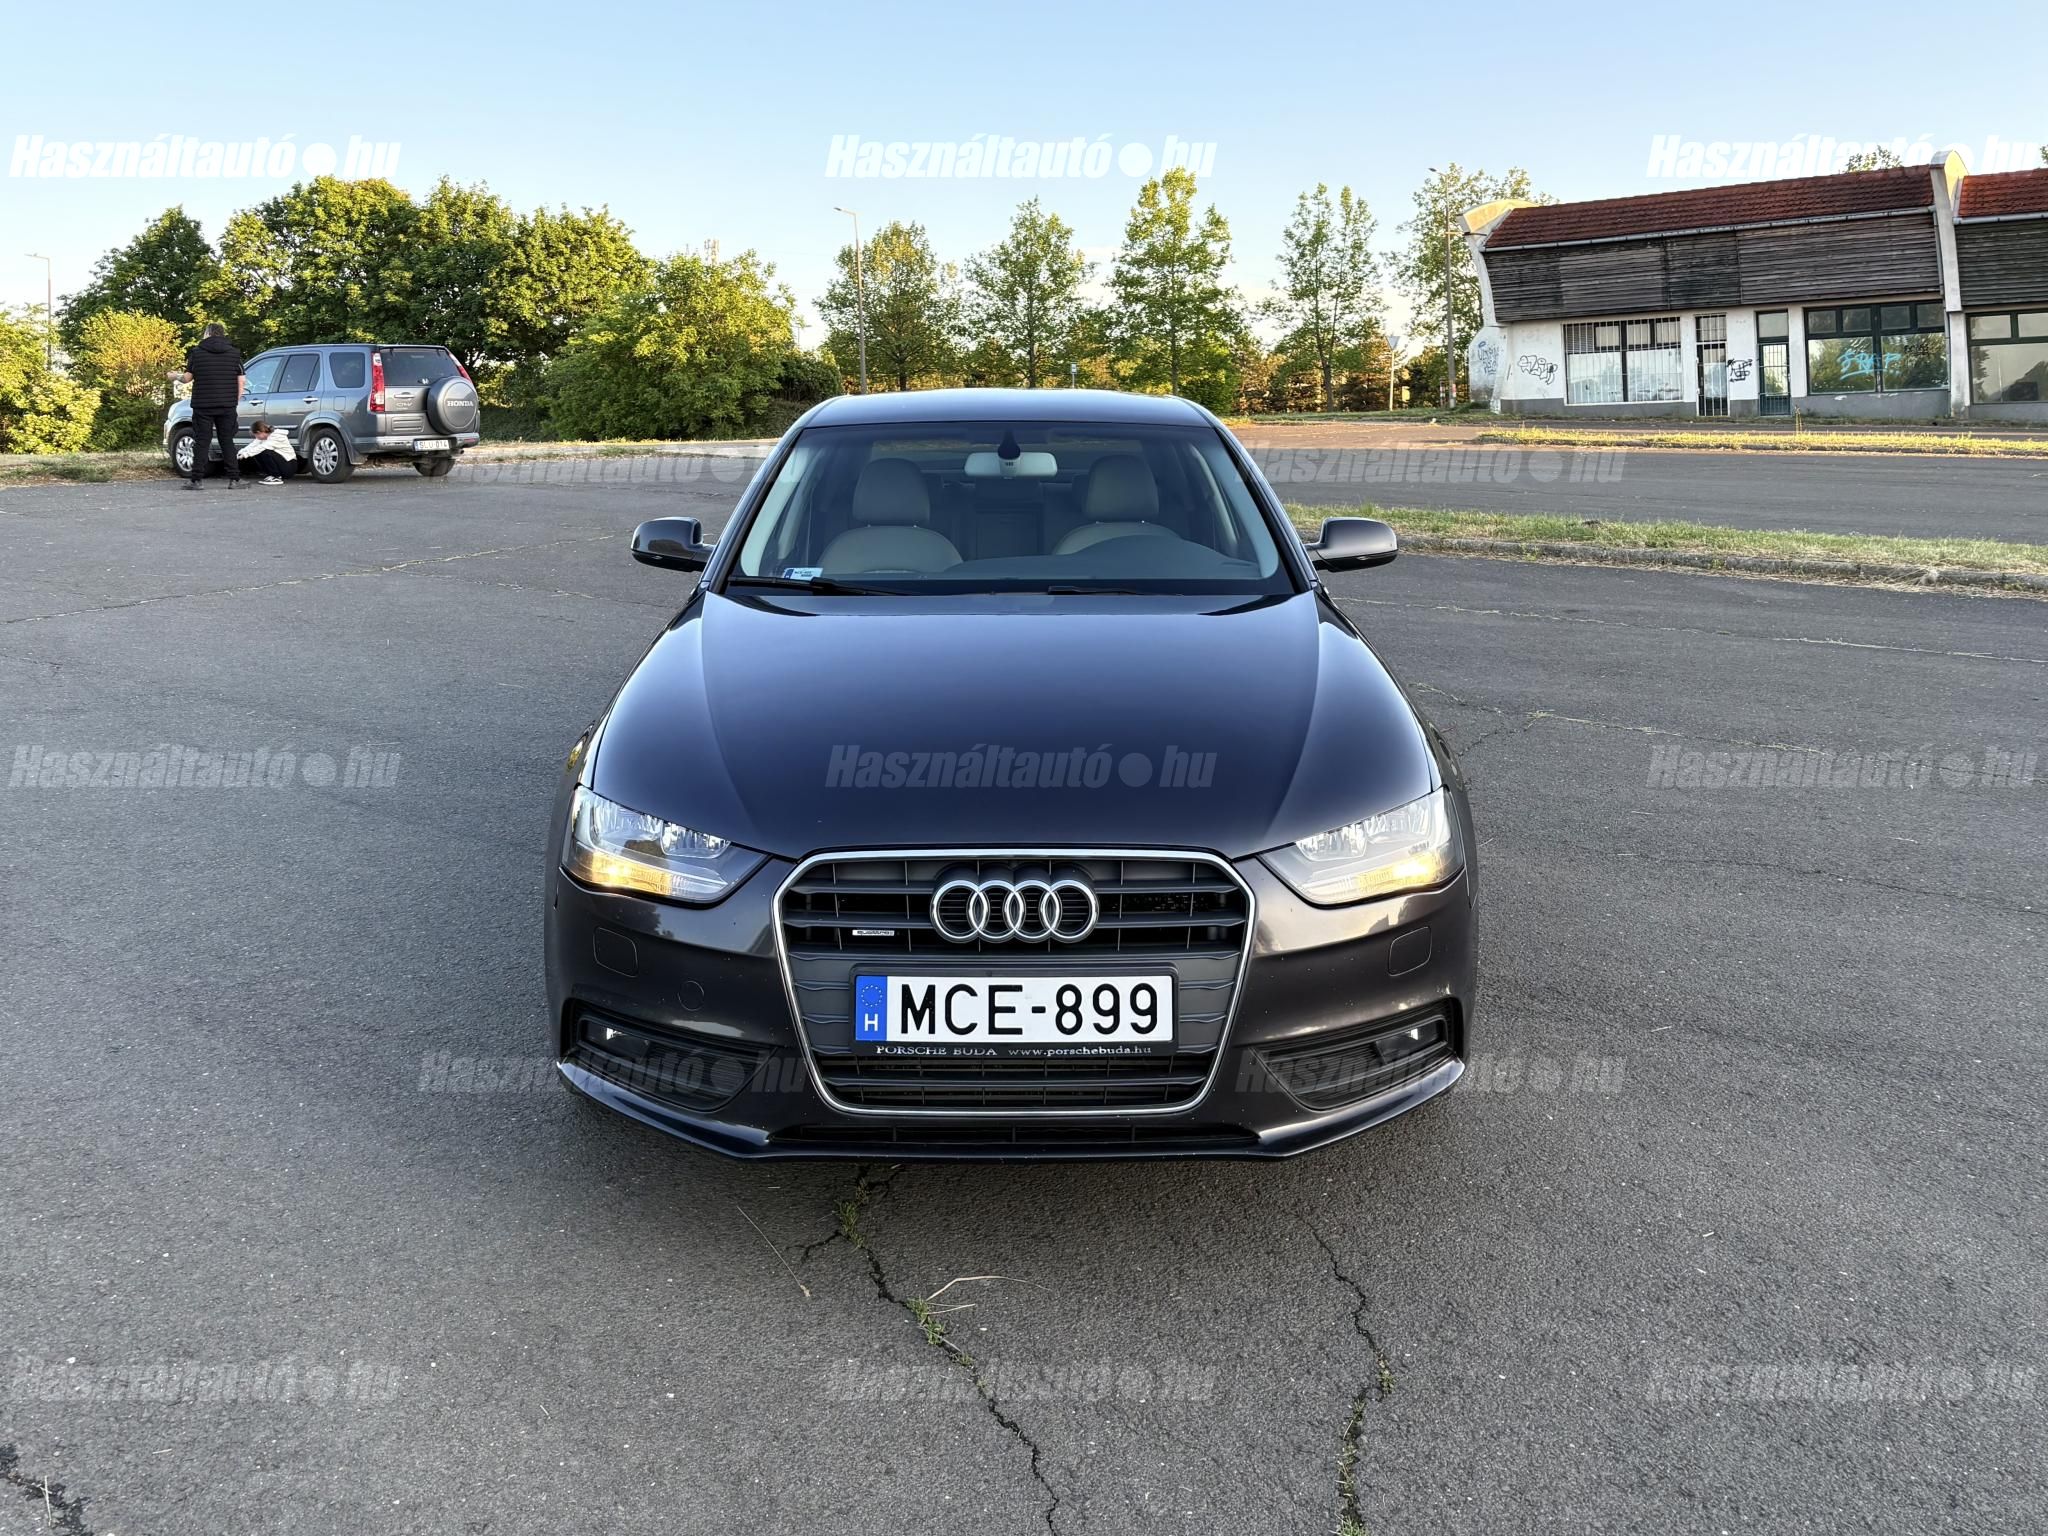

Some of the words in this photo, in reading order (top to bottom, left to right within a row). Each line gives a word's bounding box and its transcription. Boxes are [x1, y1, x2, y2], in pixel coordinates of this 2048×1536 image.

[900, 982, 1158, 1035] MCE-899
[864, 1013, 879, 1032] H
[875, 1045, 948, 1056] PORSCHE
[953, 1046, 998, 1056] BUDA
[1008, 1045, 1152, 1056] www.porschebuda.hu
